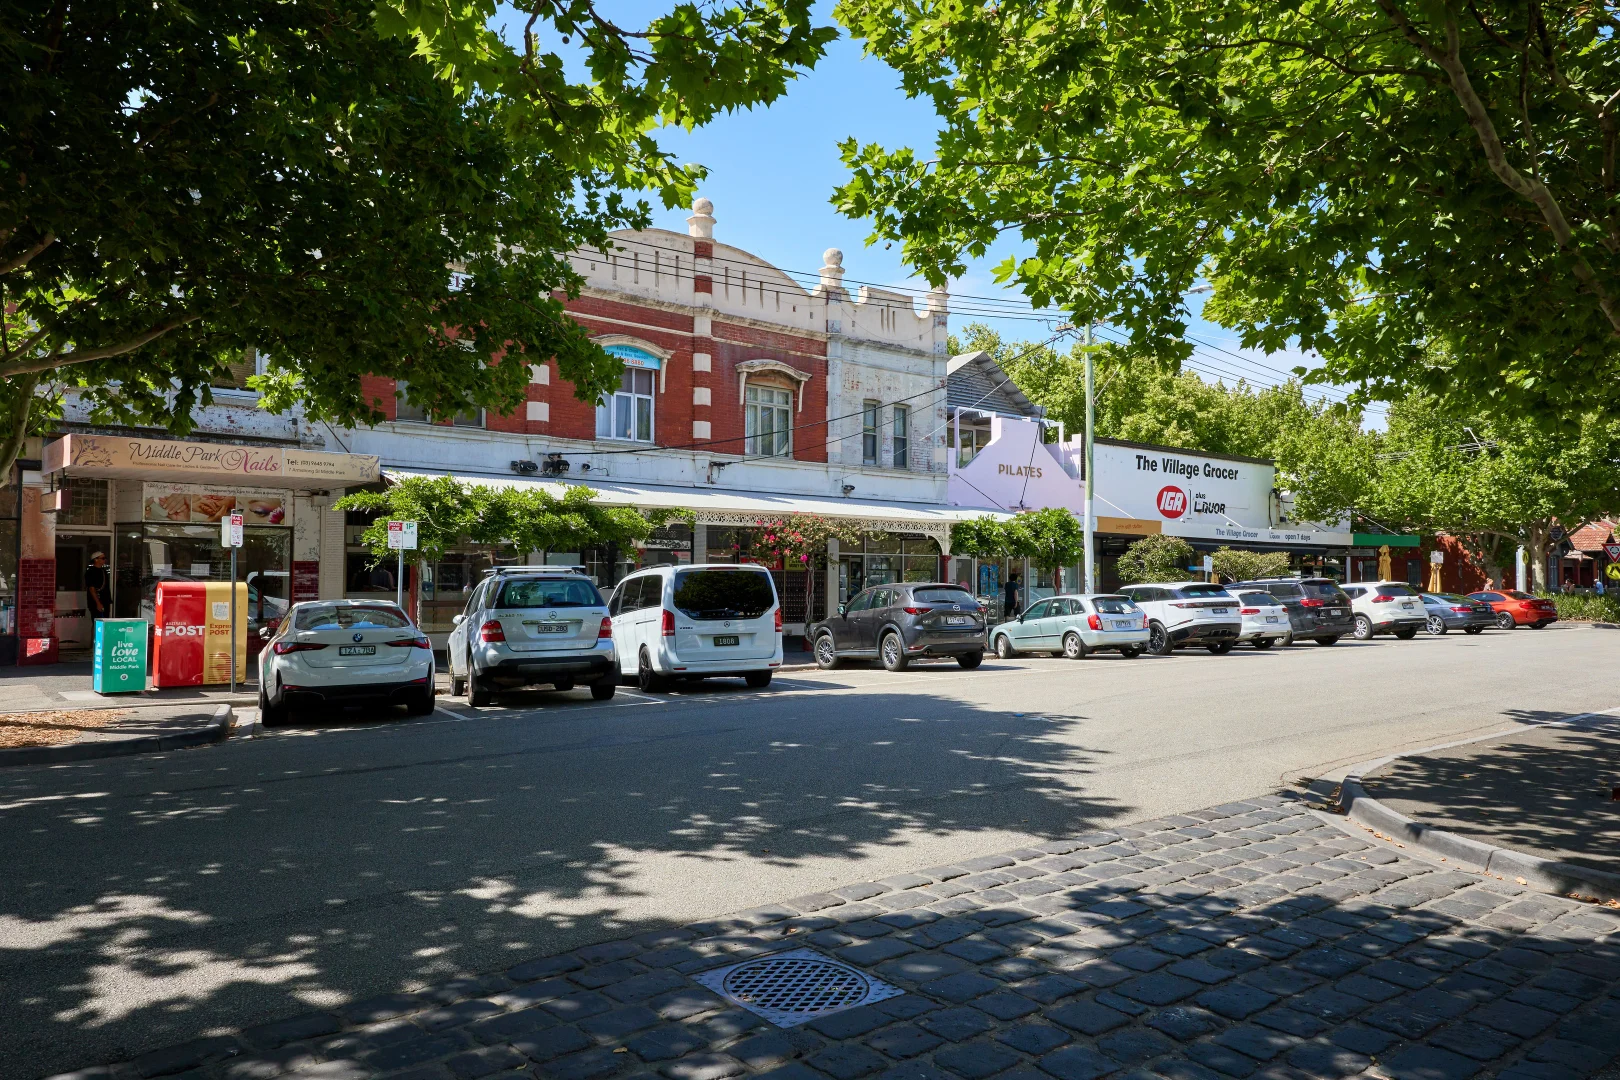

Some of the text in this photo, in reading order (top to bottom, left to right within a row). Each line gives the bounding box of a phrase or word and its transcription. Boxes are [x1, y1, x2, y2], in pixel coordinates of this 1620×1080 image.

[128, 442, 282, 473] Middle Park Nails
[286, 458, 299, 466] Tel:
[998, 463, 1043, 479] PILATES
[1136, 454, 1239, 480] The Village Grocer
[1195, 491, 1206, 500] plus
[1160, 491, 1184, 513] IGA
[405, 522, 415, 530] 1P
[1216, 528, 1259, 538] The Village Grocer
[1300, 533, 1311, 542] days
[165, 625, 206, 637] POST
[117, 640, 134, 648] live
